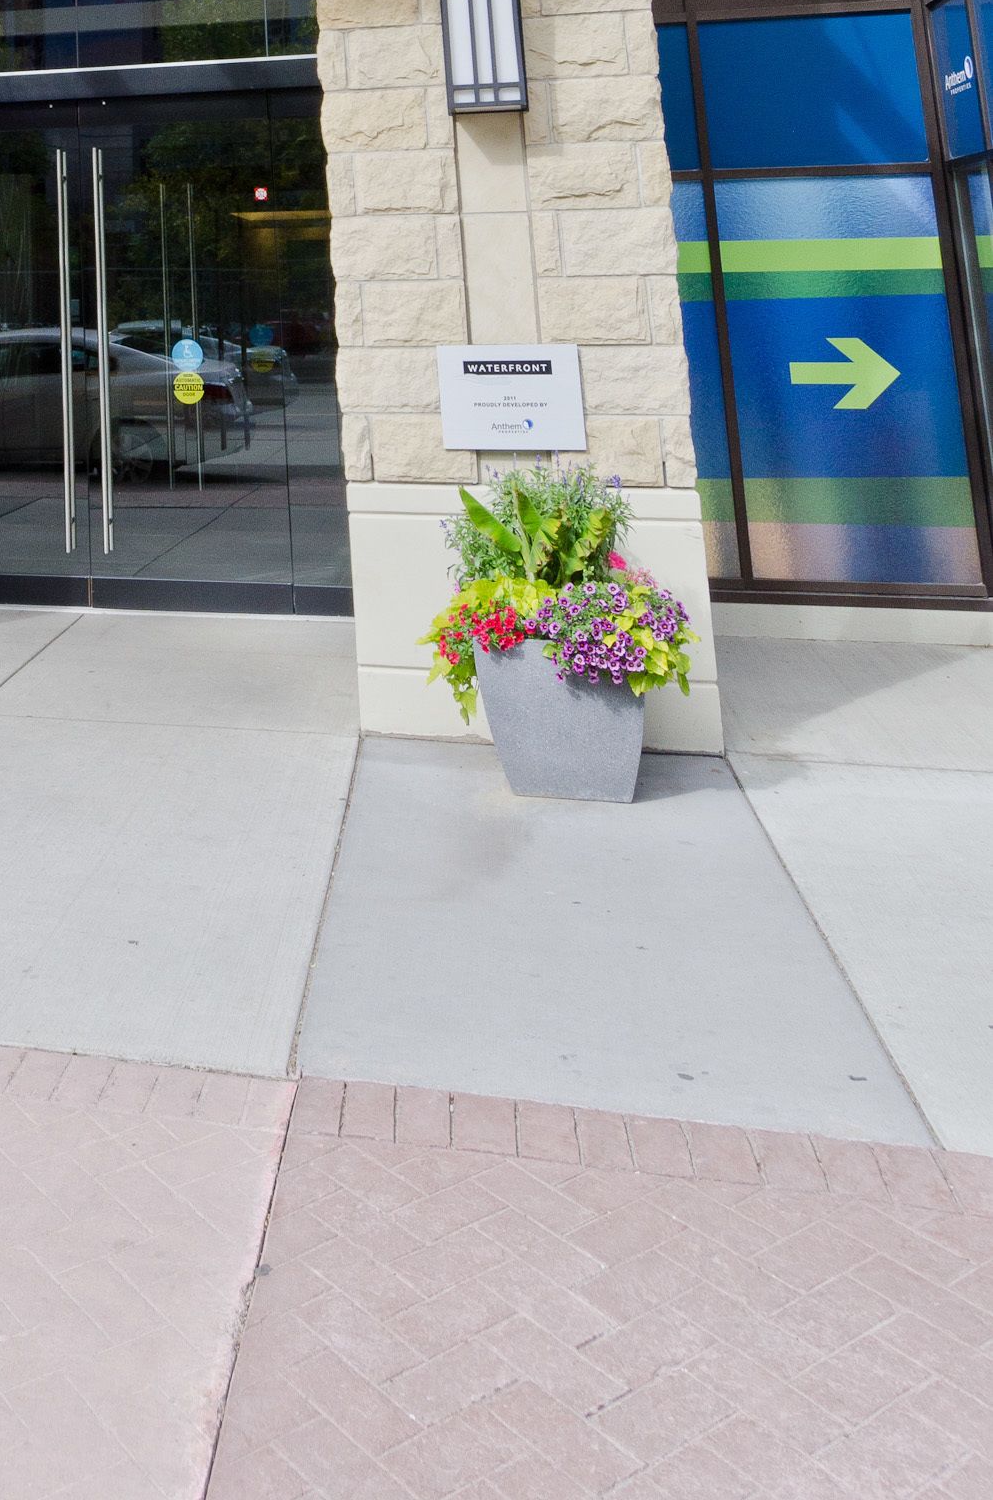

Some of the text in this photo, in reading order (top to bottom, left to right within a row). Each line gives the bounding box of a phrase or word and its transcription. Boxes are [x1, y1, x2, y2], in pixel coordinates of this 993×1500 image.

[945, 70, 967, 91] Anthem
[467, 363, 548, 373] WATERFRONT
[491, 422, 523, 430] Anthem
